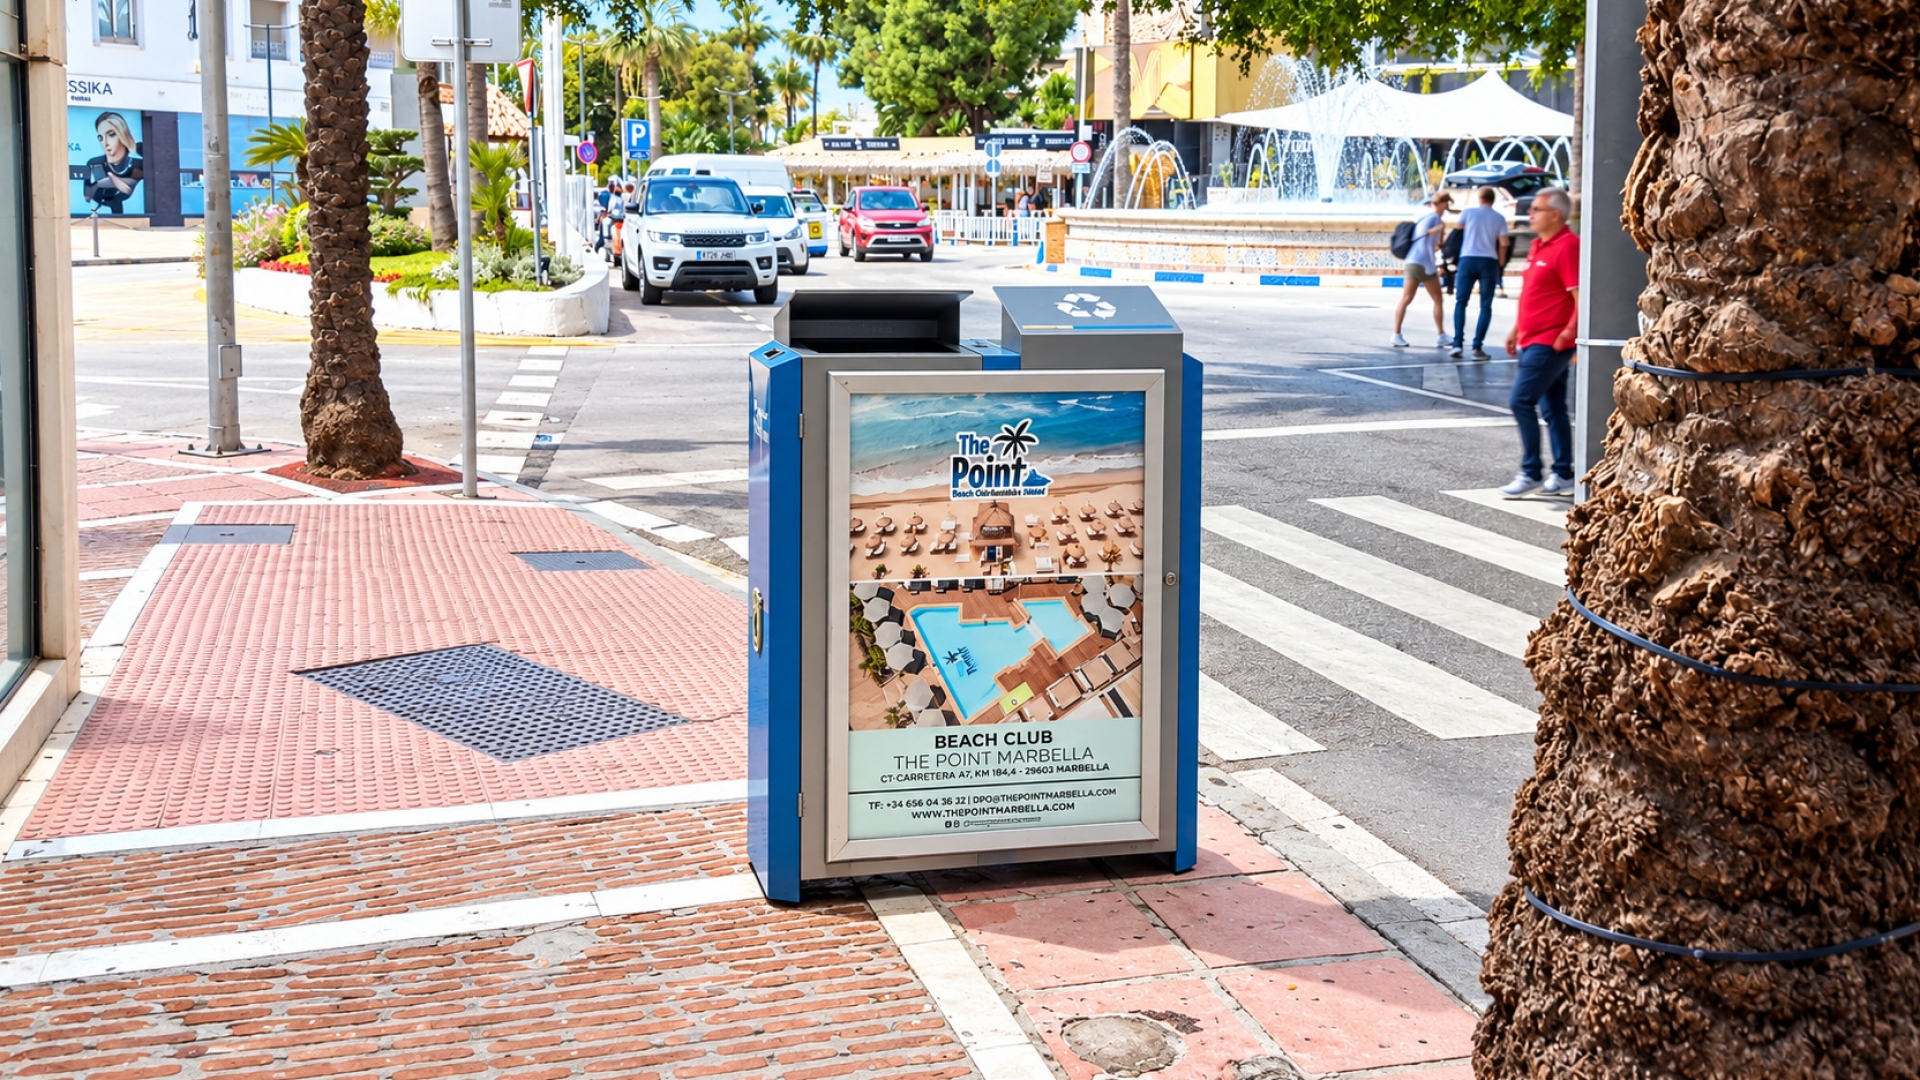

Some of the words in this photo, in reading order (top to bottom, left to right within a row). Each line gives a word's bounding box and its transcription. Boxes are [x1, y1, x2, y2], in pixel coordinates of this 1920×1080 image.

[67, 80, 113, 95] SSIKA
[631, 123, 646, 147] P
[959, 434, 990, 455] The
[952, 455, 1027, 489] Point
[935, 732, 998, 749] BEACH
[1003, 730, 1053, 745] CLUB
[893, 754, 930, 770] THE
[936, 751, 992, 767] POINT
[997, 746, 1094, 765] MARBELLA
[958, 770, 973, 780] A7,
[975, 769, 990, 778] KM
[992, 768, 1016, 777] 184,4
[1056, 763, 1110, 773] MARBELLA
[868, 801, 884, 810] TF:
[886, 800, 903, 809] +34
[905, 799, 924, 808] 656
[926, 798, 939, 807] 04
